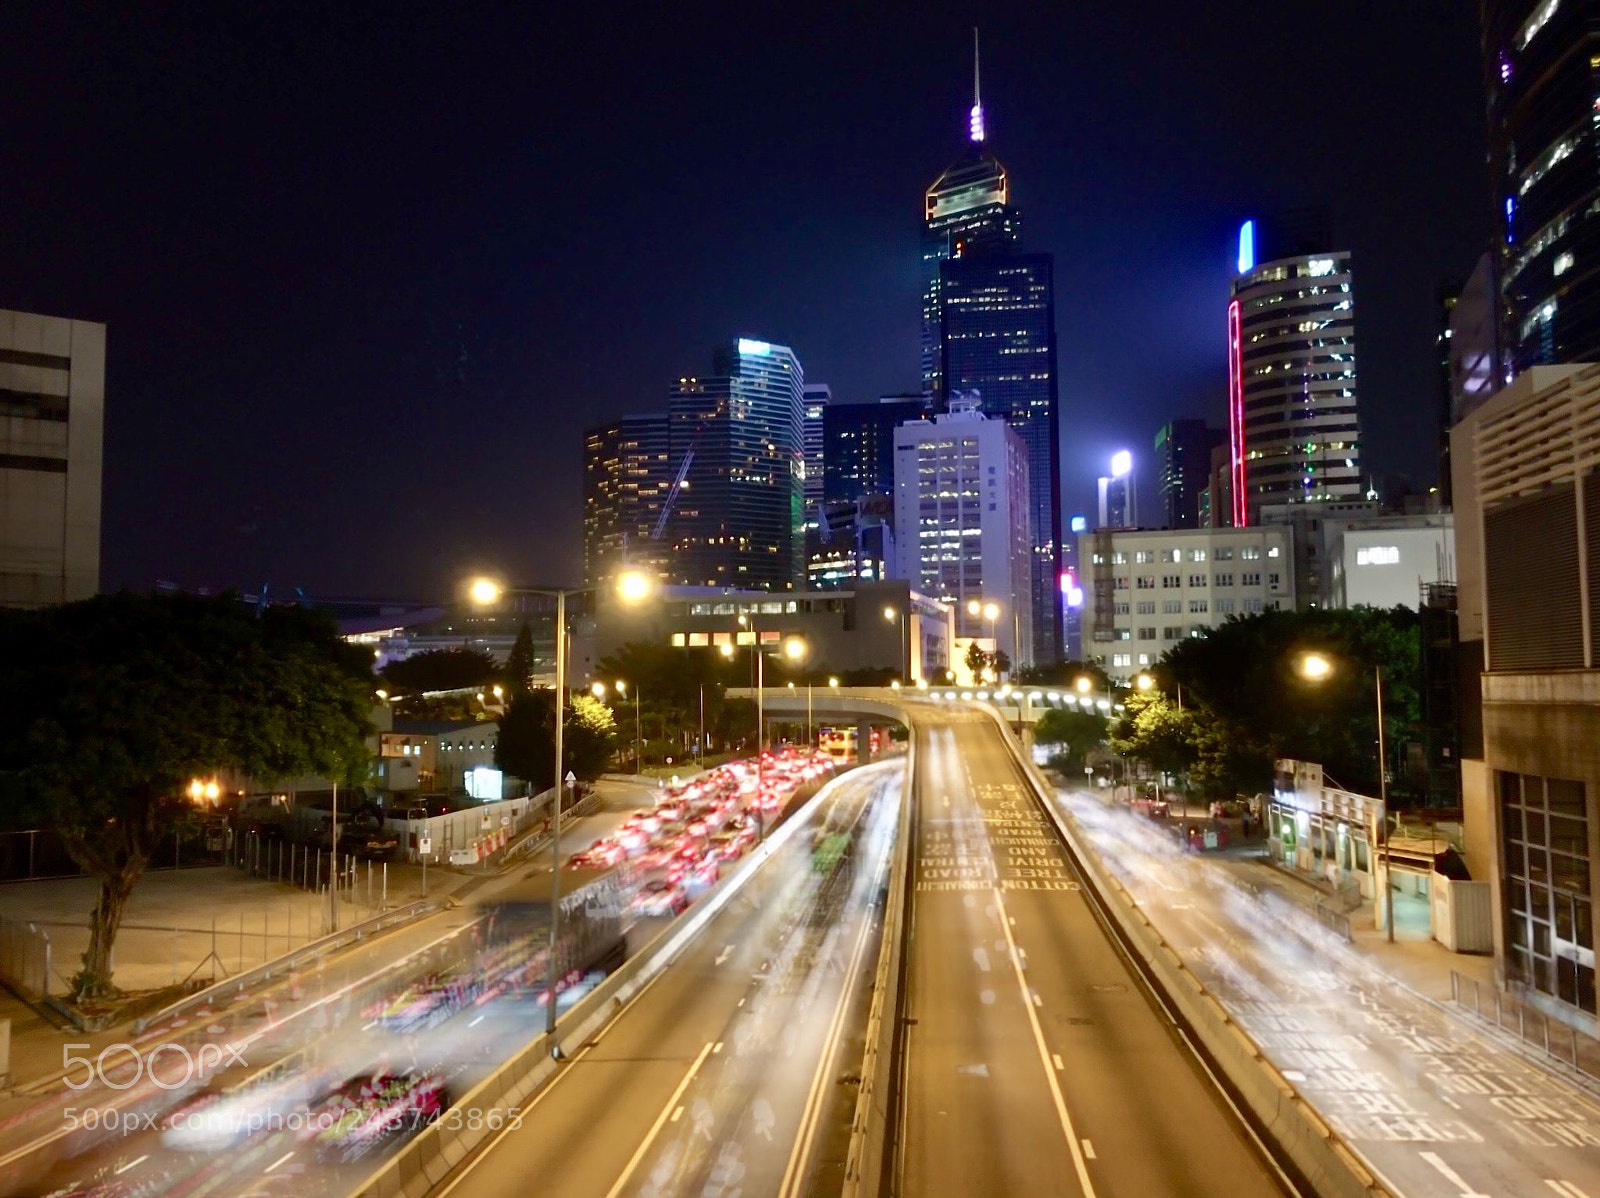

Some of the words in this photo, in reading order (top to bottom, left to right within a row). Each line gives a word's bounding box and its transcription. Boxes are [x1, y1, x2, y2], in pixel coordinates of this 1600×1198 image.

[1009, 848, 1047, 856] AND
[1007, 857, 1064, 867] DRIVE
[924, 867, 983, 879] ROAD
[1009, 868, 1066, 879] TREE
[1002, 879, 1081, 891] COTTON
